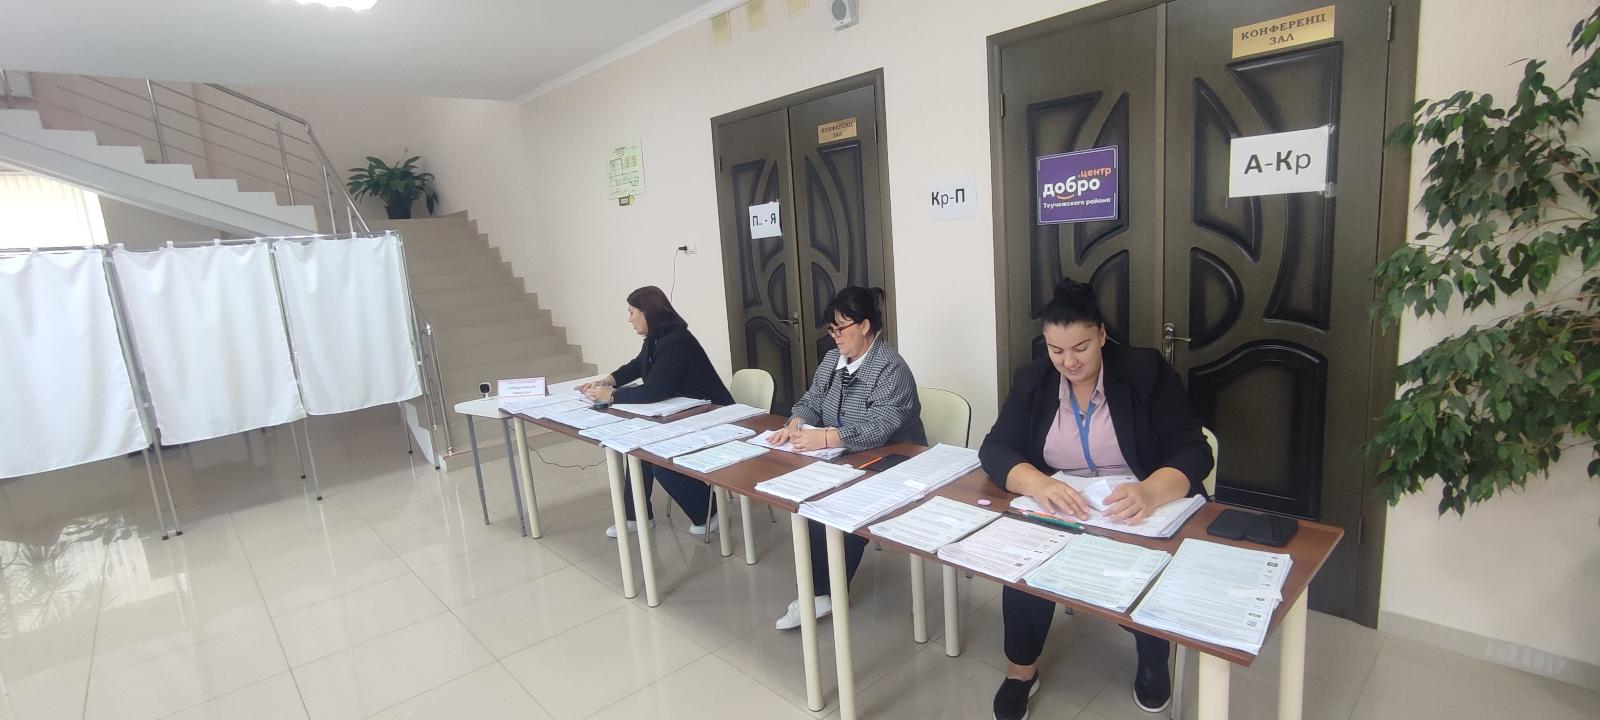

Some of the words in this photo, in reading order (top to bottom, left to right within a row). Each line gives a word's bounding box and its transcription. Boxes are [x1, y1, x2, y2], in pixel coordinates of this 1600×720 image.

[1241, 13, 1326, 40] КОНФЕРЕНЦ
[1269, 33, 1294, 45] ЗАЛ
[1244, 150, 1311, 175] А-Кр
[1043, 176, 1100, 197] добро
[931, 188, 965, 208] Кр-П
[1043, 201, 1085, 209] Теучежского
[1086, 197, 1111, 205] района
[770, 212, 776, 224] Я
